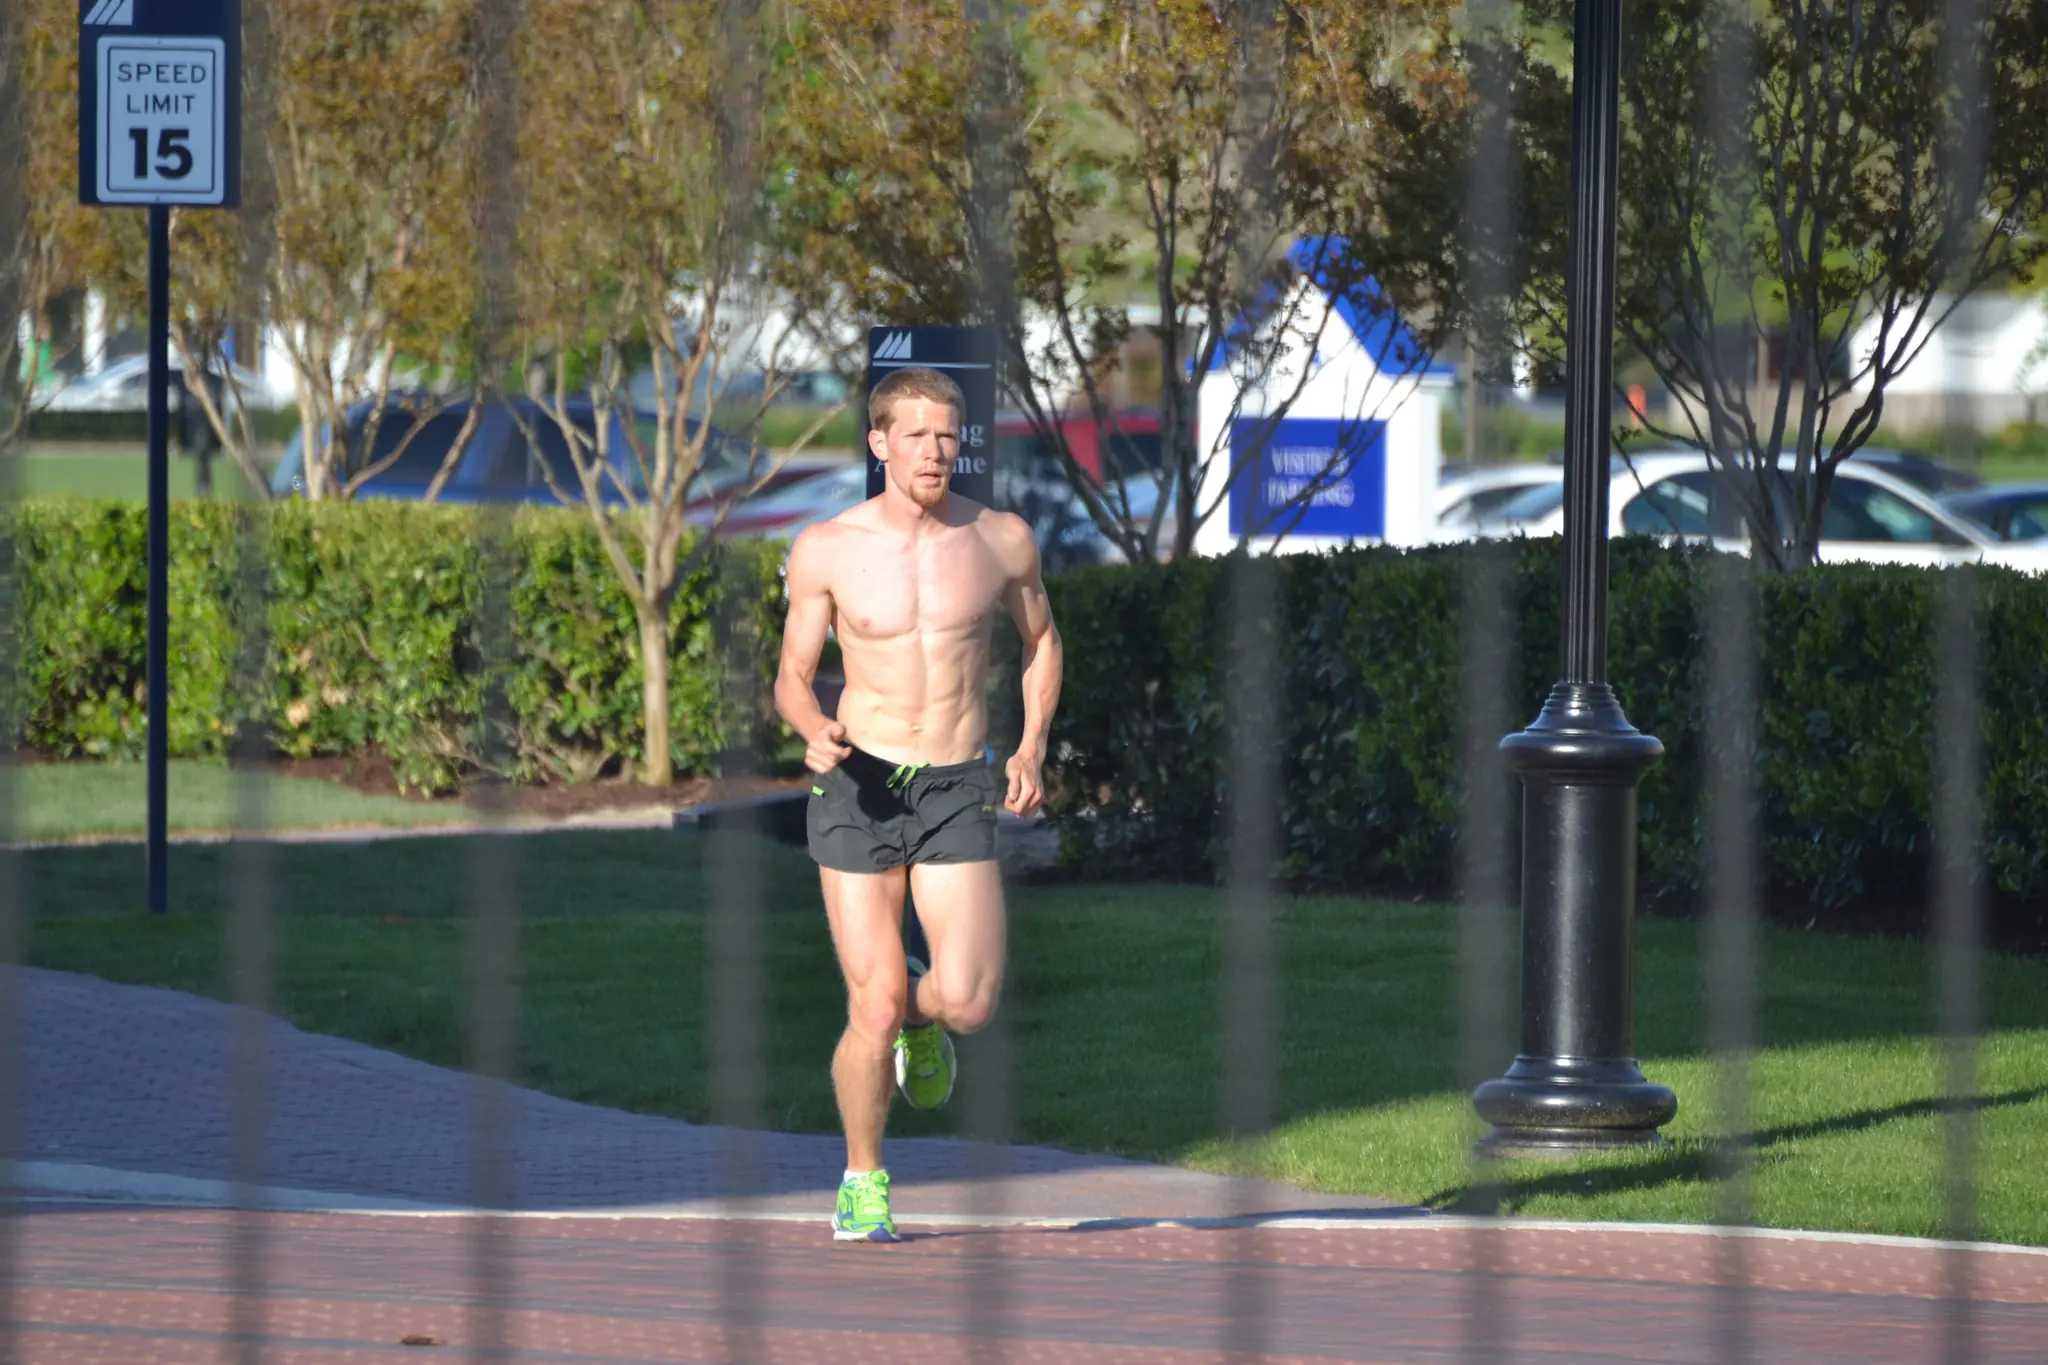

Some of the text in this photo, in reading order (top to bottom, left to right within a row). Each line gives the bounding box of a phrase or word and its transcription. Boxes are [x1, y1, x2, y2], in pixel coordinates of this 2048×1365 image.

[117, 63, 206, 84] SPEED
[126, 94, 195, 114] LIMIT
[128, 128, 193, 180] 15
